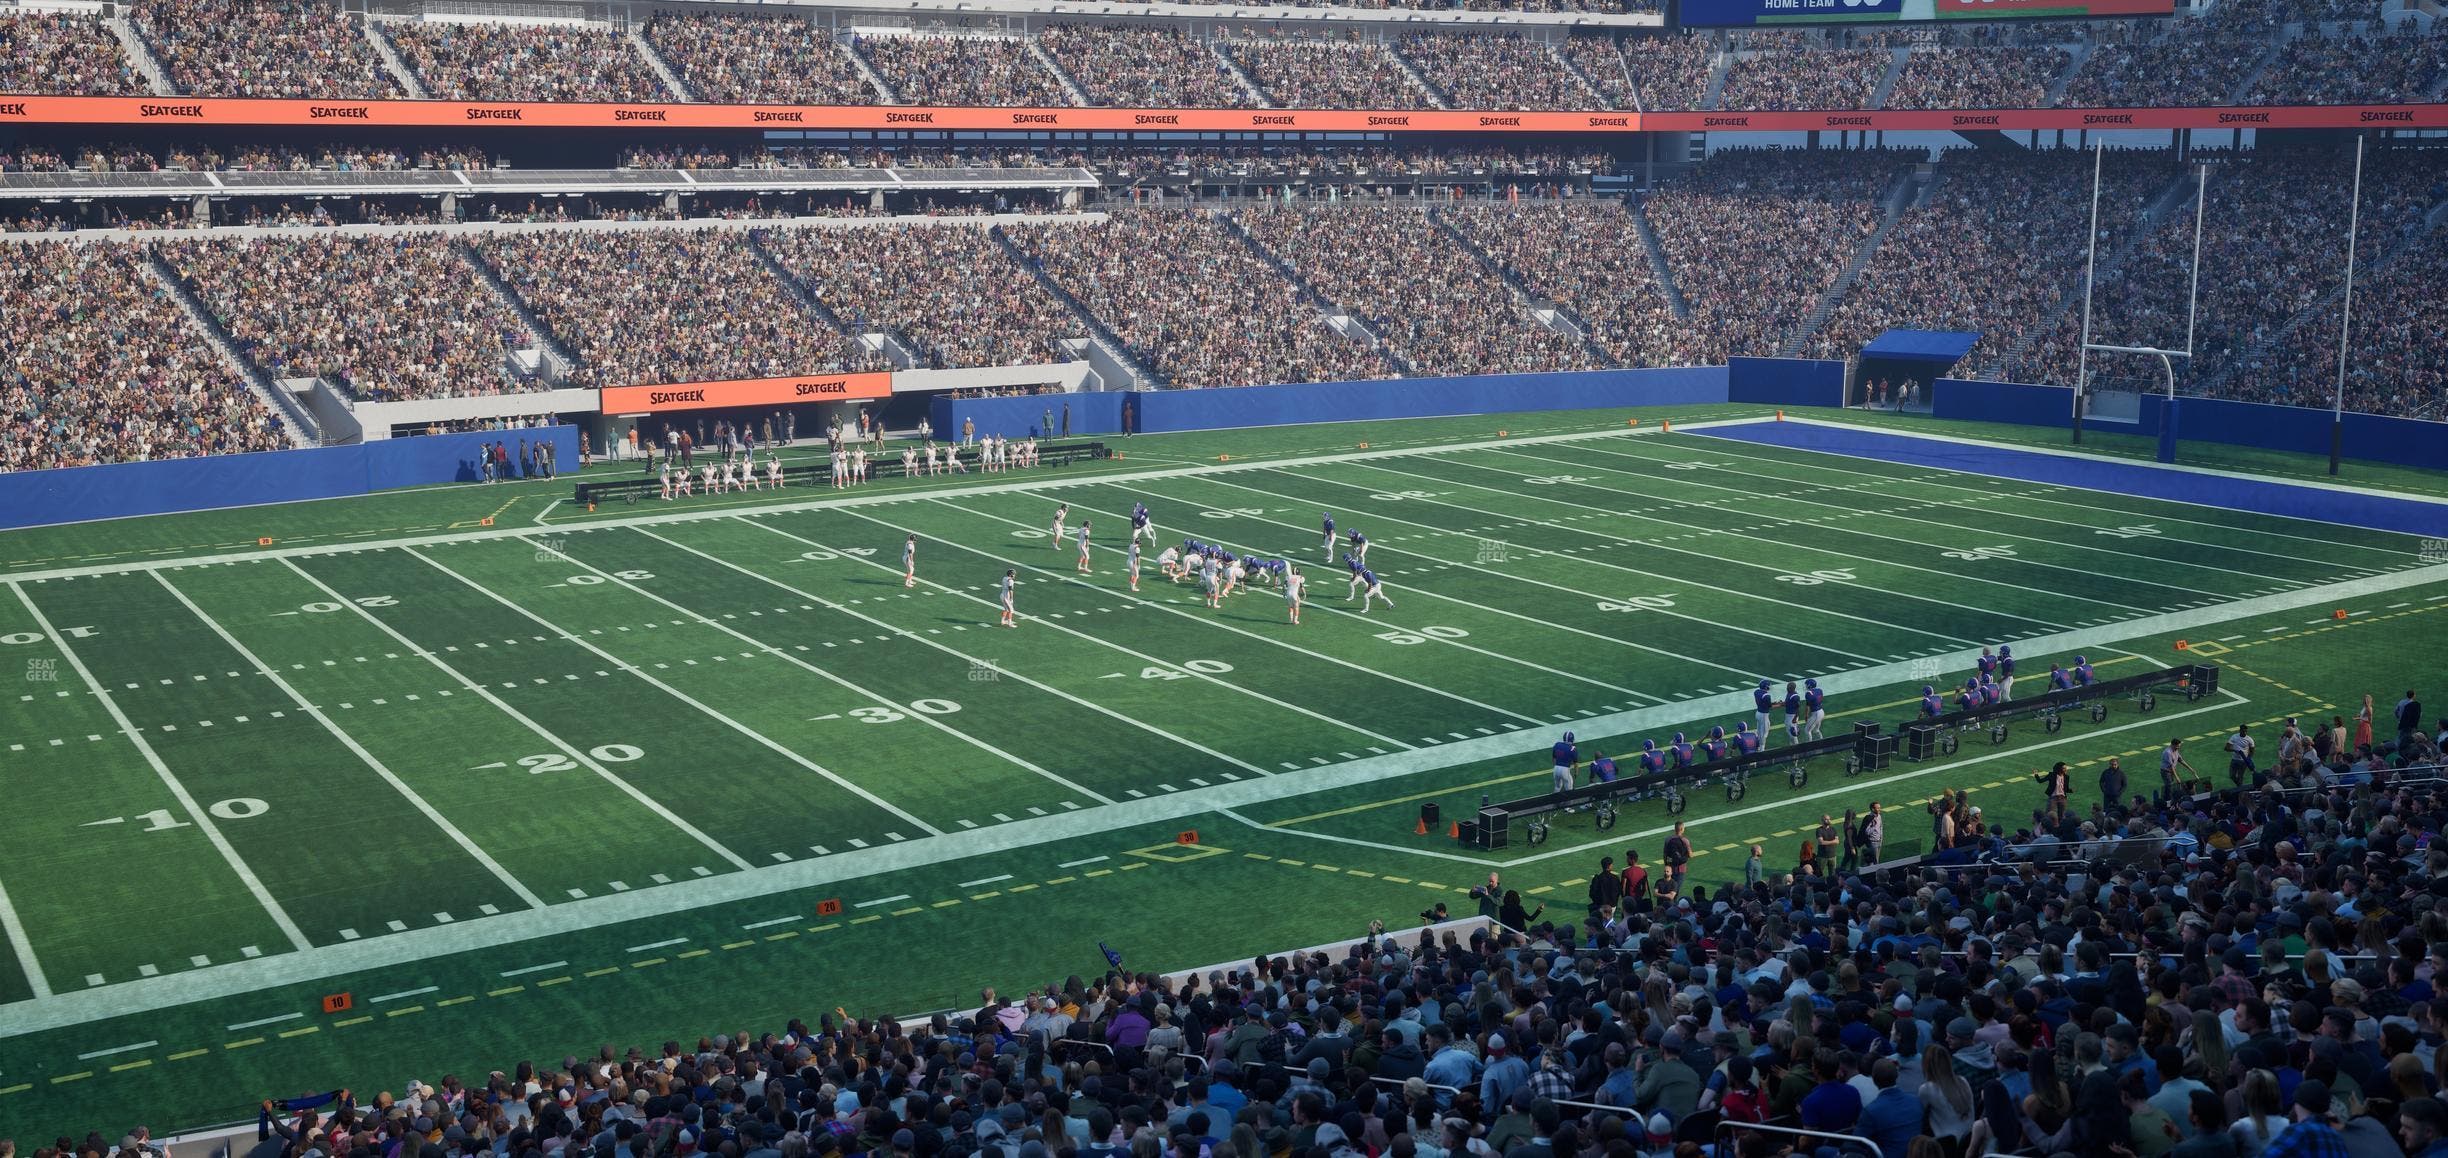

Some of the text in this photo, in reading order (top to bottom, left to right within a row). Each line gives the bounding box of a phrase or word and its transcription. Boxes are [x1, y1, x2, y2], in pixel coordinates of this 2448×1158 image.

[141, 105, 203, 118] SEATGEEK
[310, 107, 368, 119] SEATGEEK
[467, 109, 522, 121] SEATGEEK
[615, 110, 666, 122] SEATGEEK
[754, 112, 803, 123] SEATGEEK
[2218, 112, 2269, 123] SEATGEEK
[2360, 110, 2414, 122] SEATGEEK
[886, 113, 933, 124] SEATGEEK
[1013, 114, 1057, 124] SEATGEEK
[1135, 115, 1178, 125] SEATGEEK
[1253, 115, 1294, 125] SEATGEEK
[1368, 116, 1409, 126] SEATGEEK
[1480, 116, 1520, 126] SEATGEEK
[1590, 117, 1628, 126] SEATGEEK
[1704, 117, 1748, 126] SEATGEEK
[1827, 116, 1871, 126] SEATGEEK
[1953, 115, 1999, 126] SEATGEEK
[2083, 114, 2132, 125] SEATGEEK
[795, 381, 847, 396] SEATGEEK
[650, 389, 705, 405] SEATGEEK
[801, 547, 878, 561] 40
[564, 569, 656, 586] 30
[1774, 568, 1857, 586] 30
[301, 595, 399, 613] 20
[1596, 594, 1676, 612] 40
[1372, 626, 1470, 645] 50
[1140, 659, 1234, 681] 40
[848, 698, 963, 724] 30
[516, 743, 645, 775] 20
[135, 797, 270, 833] 10
[1184, 832, 1195, 842] 30
[824, 901, 836, 913] 20
[331, 996, 344, 1009] 10
